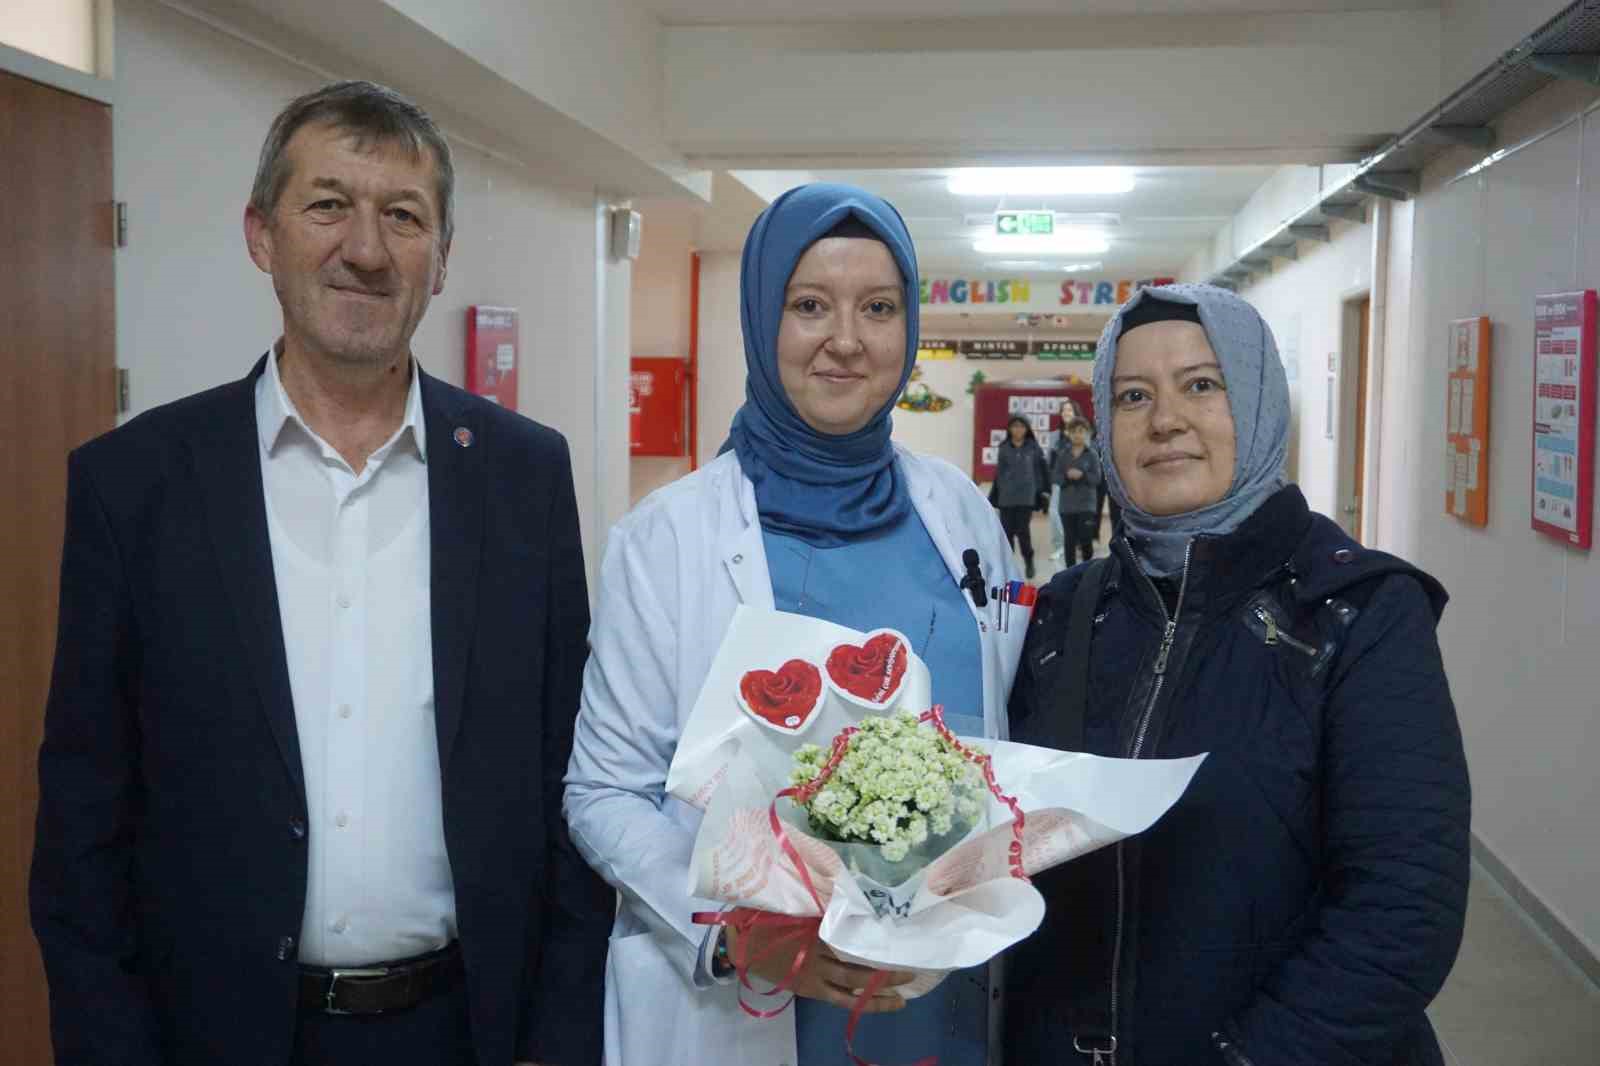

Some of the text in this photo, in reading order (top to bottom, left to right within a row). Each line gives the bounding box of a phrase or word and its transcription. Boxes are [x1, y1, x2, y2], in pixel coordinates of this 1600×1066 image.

[919, 277, 1174, 305] ENGLISH STRE
[1042, 342, 1089, 352] SPRING
